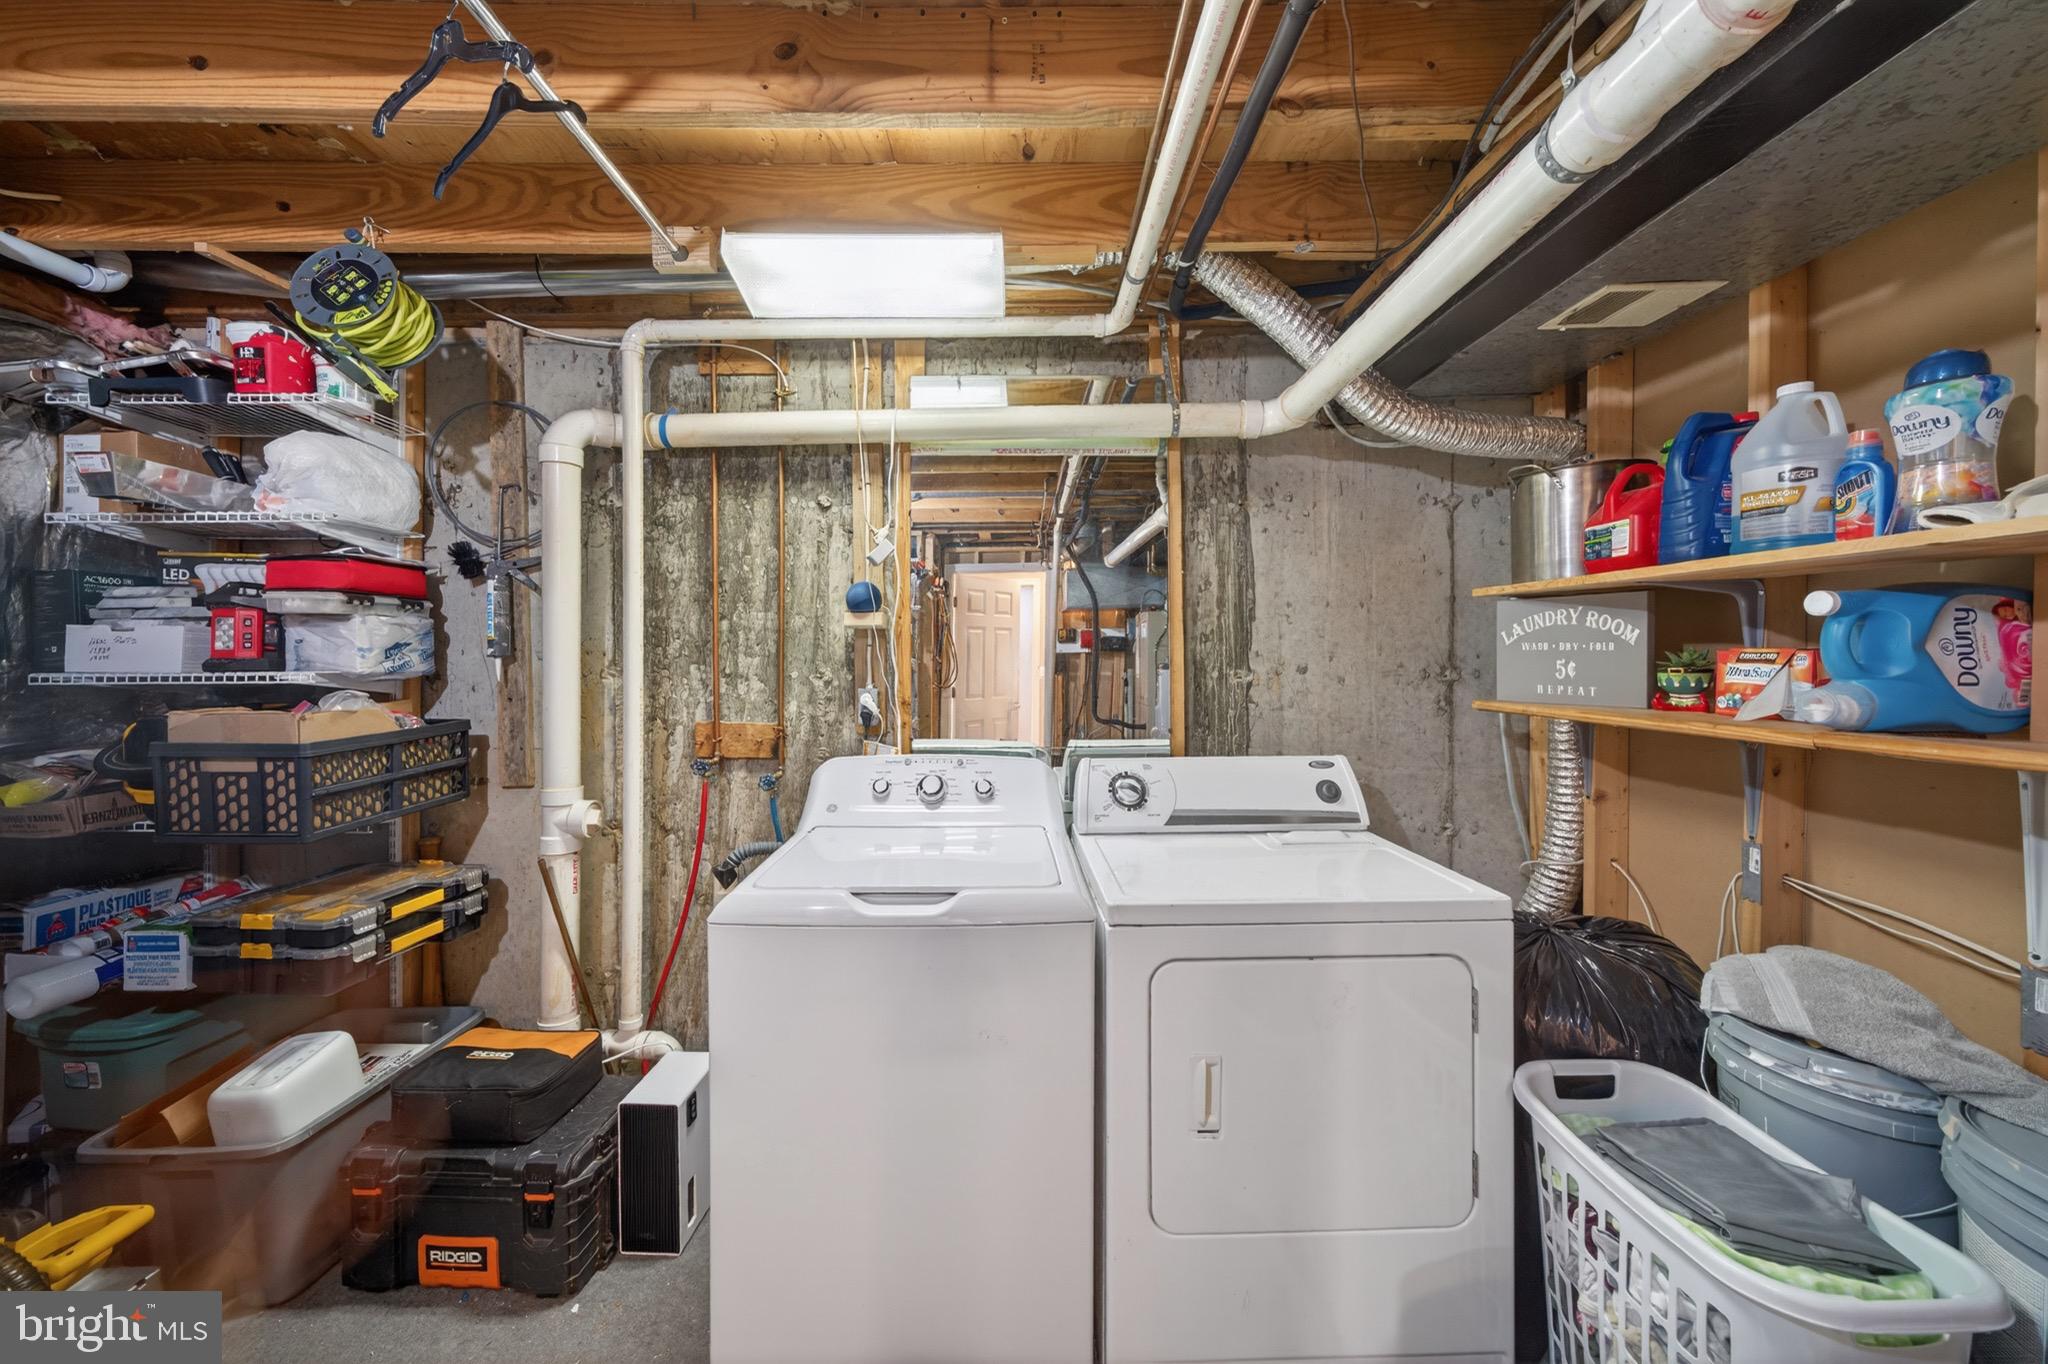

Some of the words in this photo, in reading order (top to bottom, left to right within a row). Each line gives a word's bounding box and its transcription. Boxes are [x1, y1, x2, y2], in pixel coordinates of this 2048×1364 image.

[1892, 415, 1951, 437] Downy
[162, 568, 190, 580] LED
[1500, 606, 1584, 646] LAUNDRY
[1585, 610, 1641, 646] ROOM
[1559, 641, 1579, 651] DRY
[1589, 641, 1615, 651] FOLD
[1953, 607, 1981, 688] Downy
[1555, 658, 1577, 680] 5¢
[1537, 684, 1597, 697] REPEAT
[79, 888, 152, 922] PLASTIQUE
[429, 1249, 482, 1264] RIDGID
